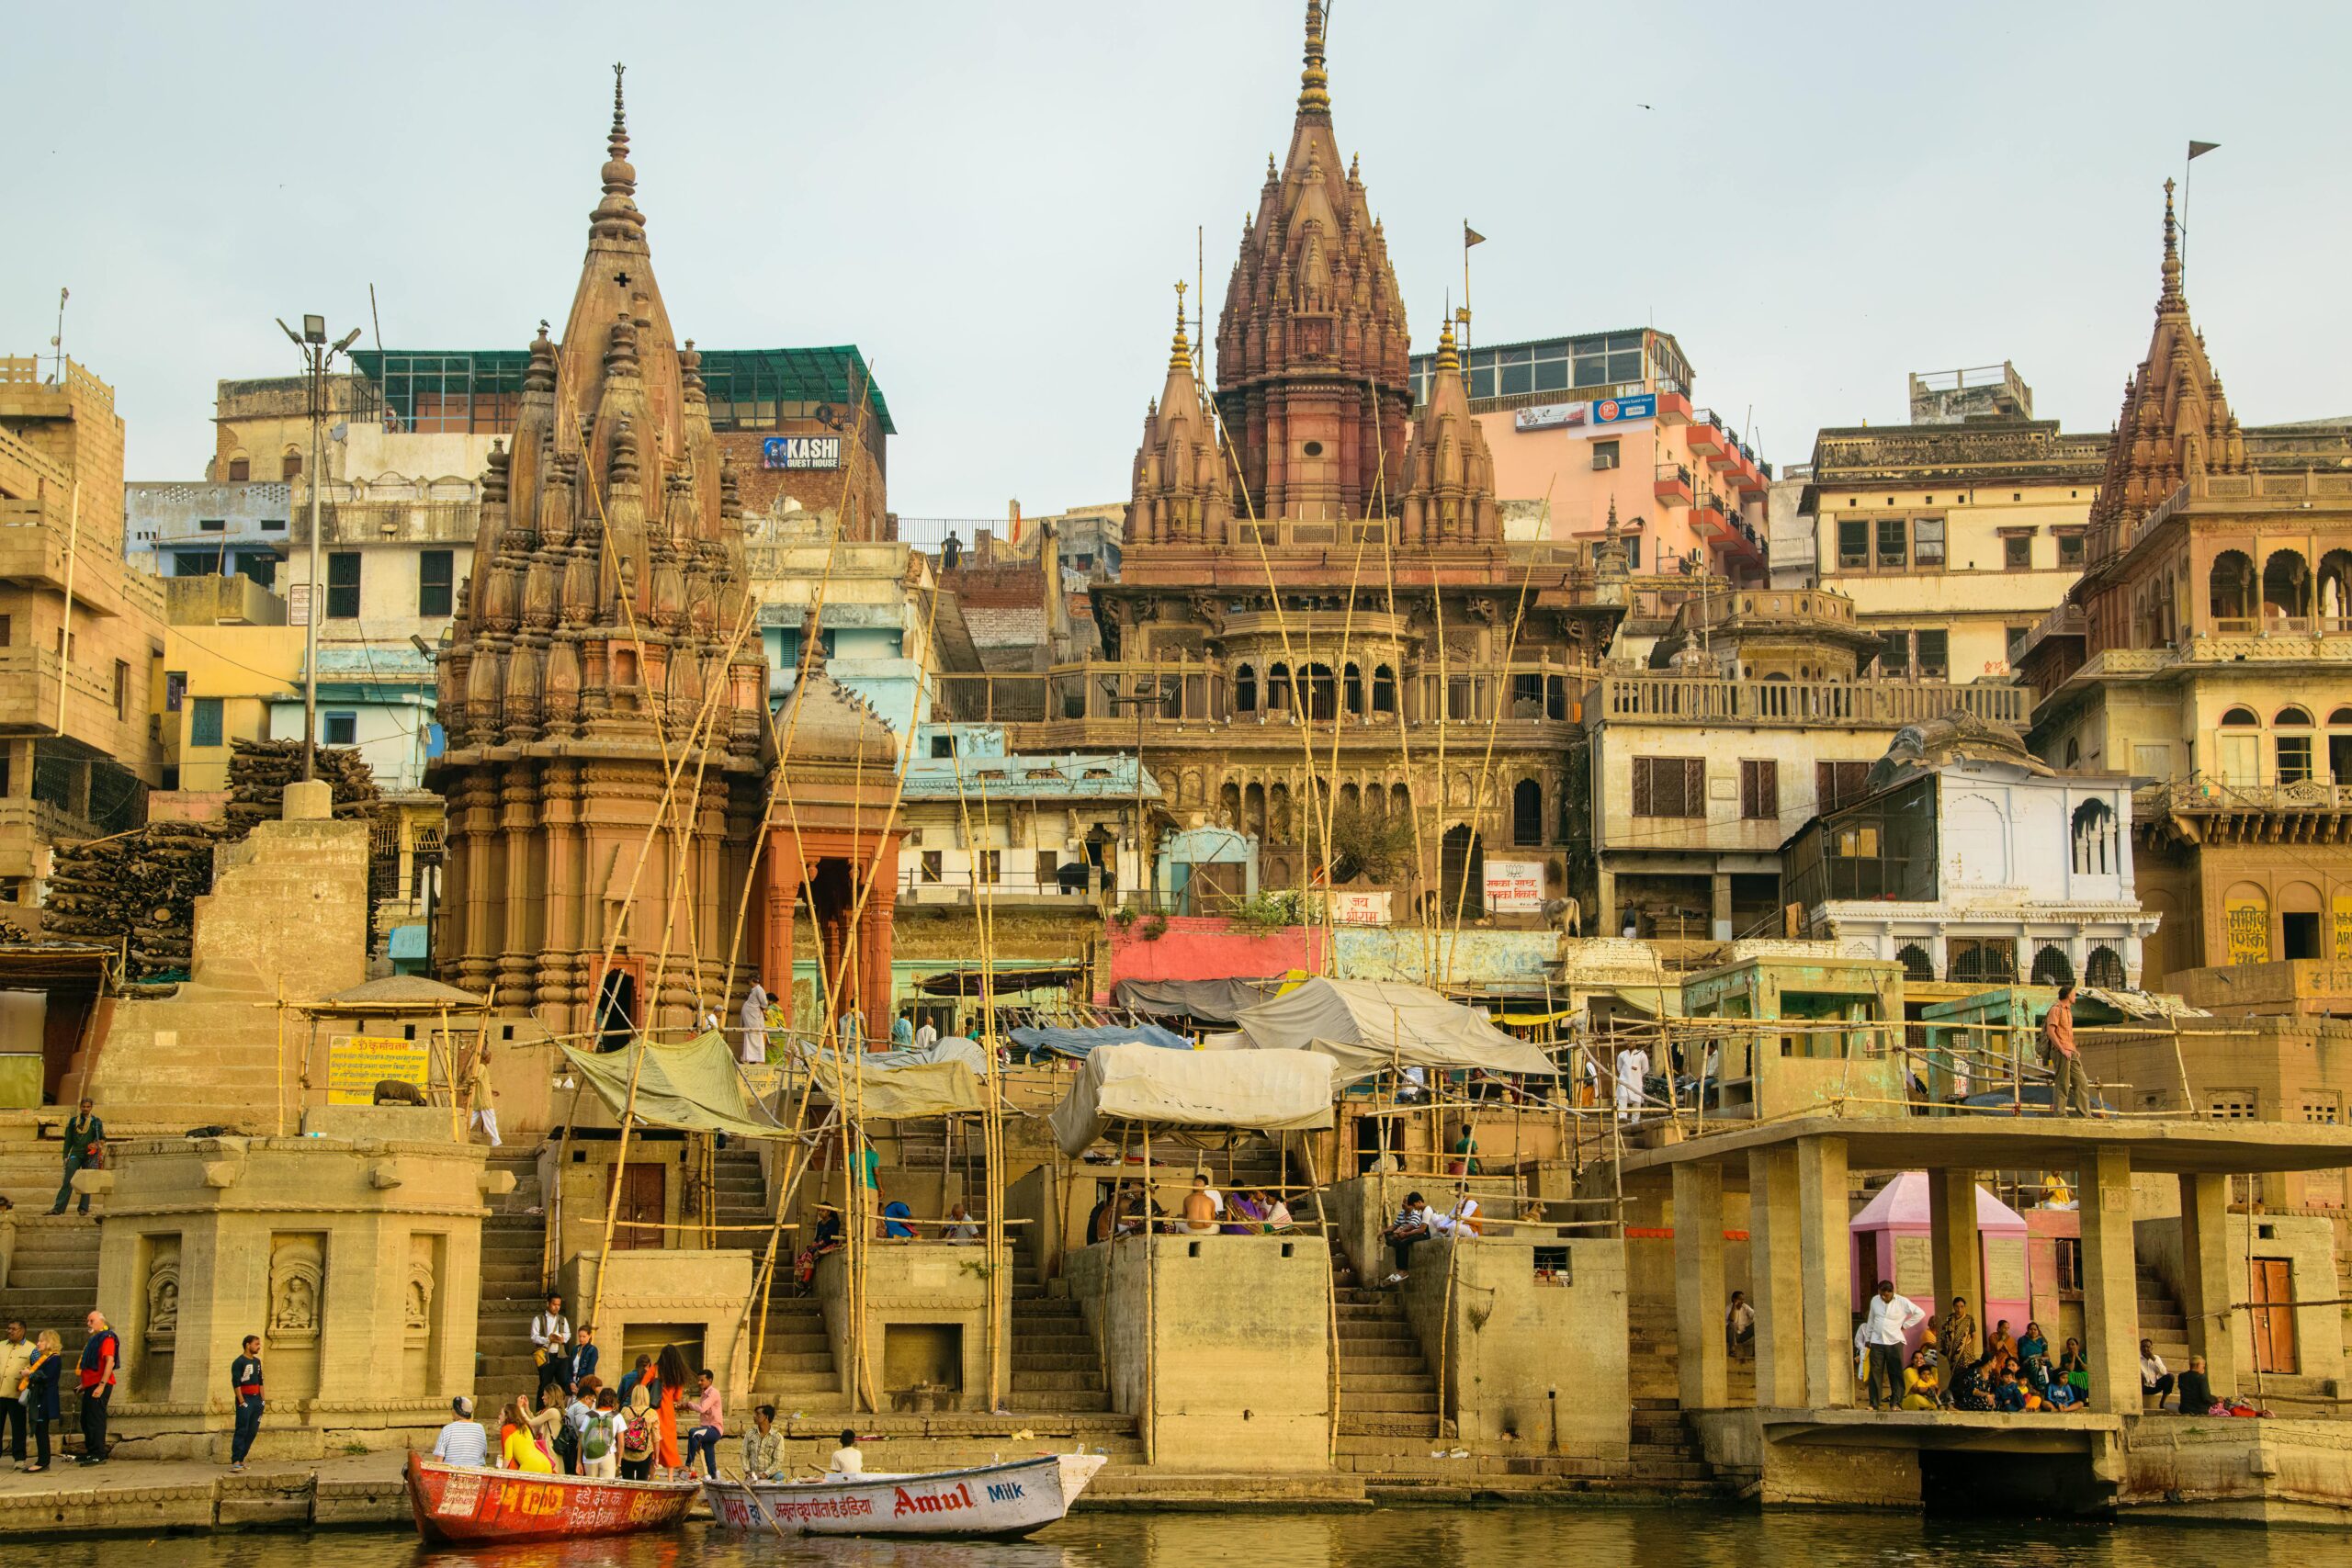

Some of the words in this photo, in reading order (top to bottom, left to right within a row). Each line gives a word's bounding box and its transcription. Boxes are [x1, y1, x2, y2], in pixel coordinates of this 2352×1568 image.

[787, 439, 839, 459] KASHI
[787, 459, 810, 468] GUEST
[812, 459, 838, 468] HOUSE
[527, 1488, 559, 1512] pnb
[893, 1483, 975, 1519] Amul
[987, 1482, 1026, 1504] Milk
[774, 1503, 796, 1523] अमूल
